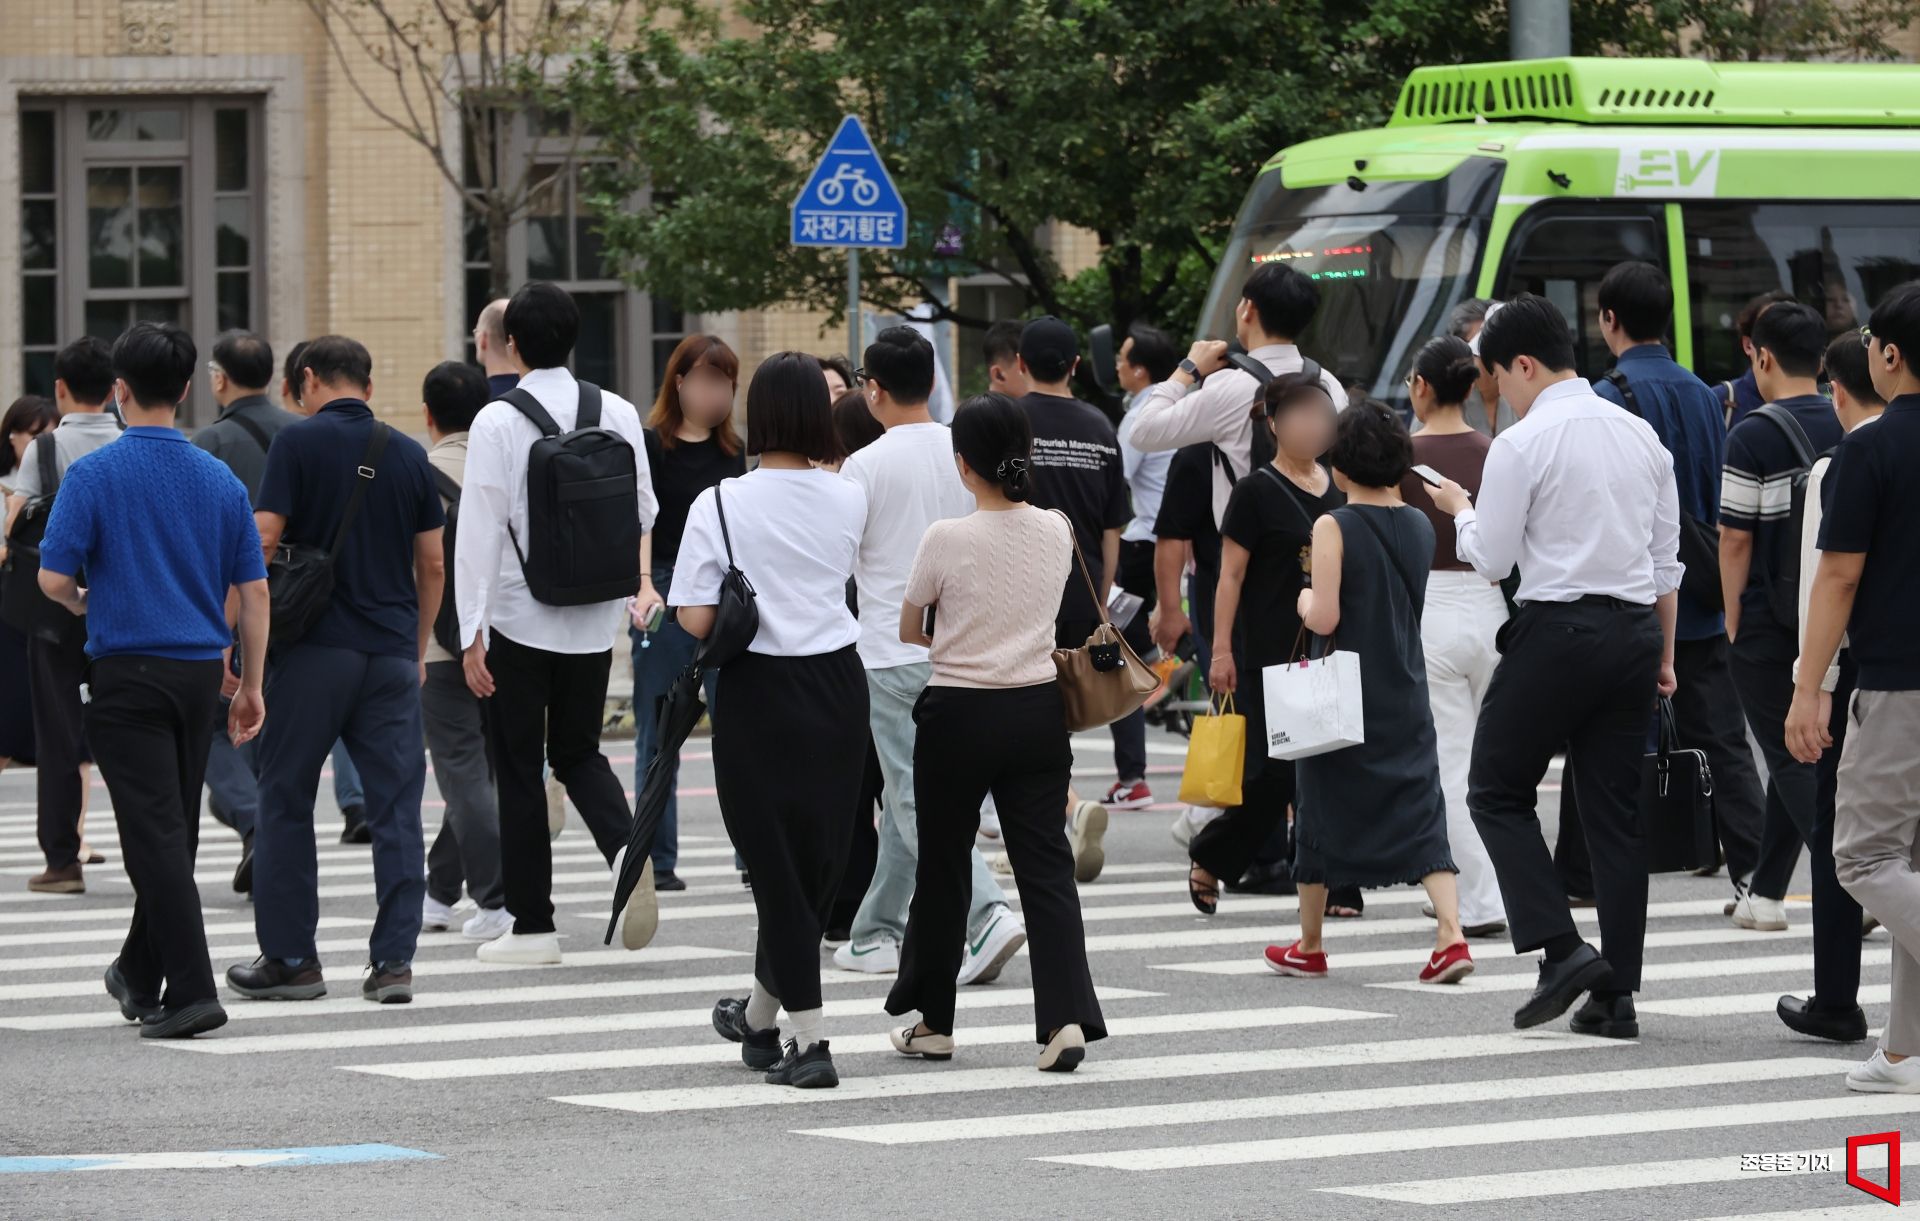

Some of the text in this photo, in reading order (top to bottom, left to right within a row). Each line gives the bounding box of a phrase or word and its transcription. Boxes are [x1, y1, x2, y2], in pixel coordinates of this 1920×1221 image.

[1632, 150, 1716, 188] EV
[800, 215, 895, 242] 자전거횡단
[1033, 438, 1067, 447] Flourish
